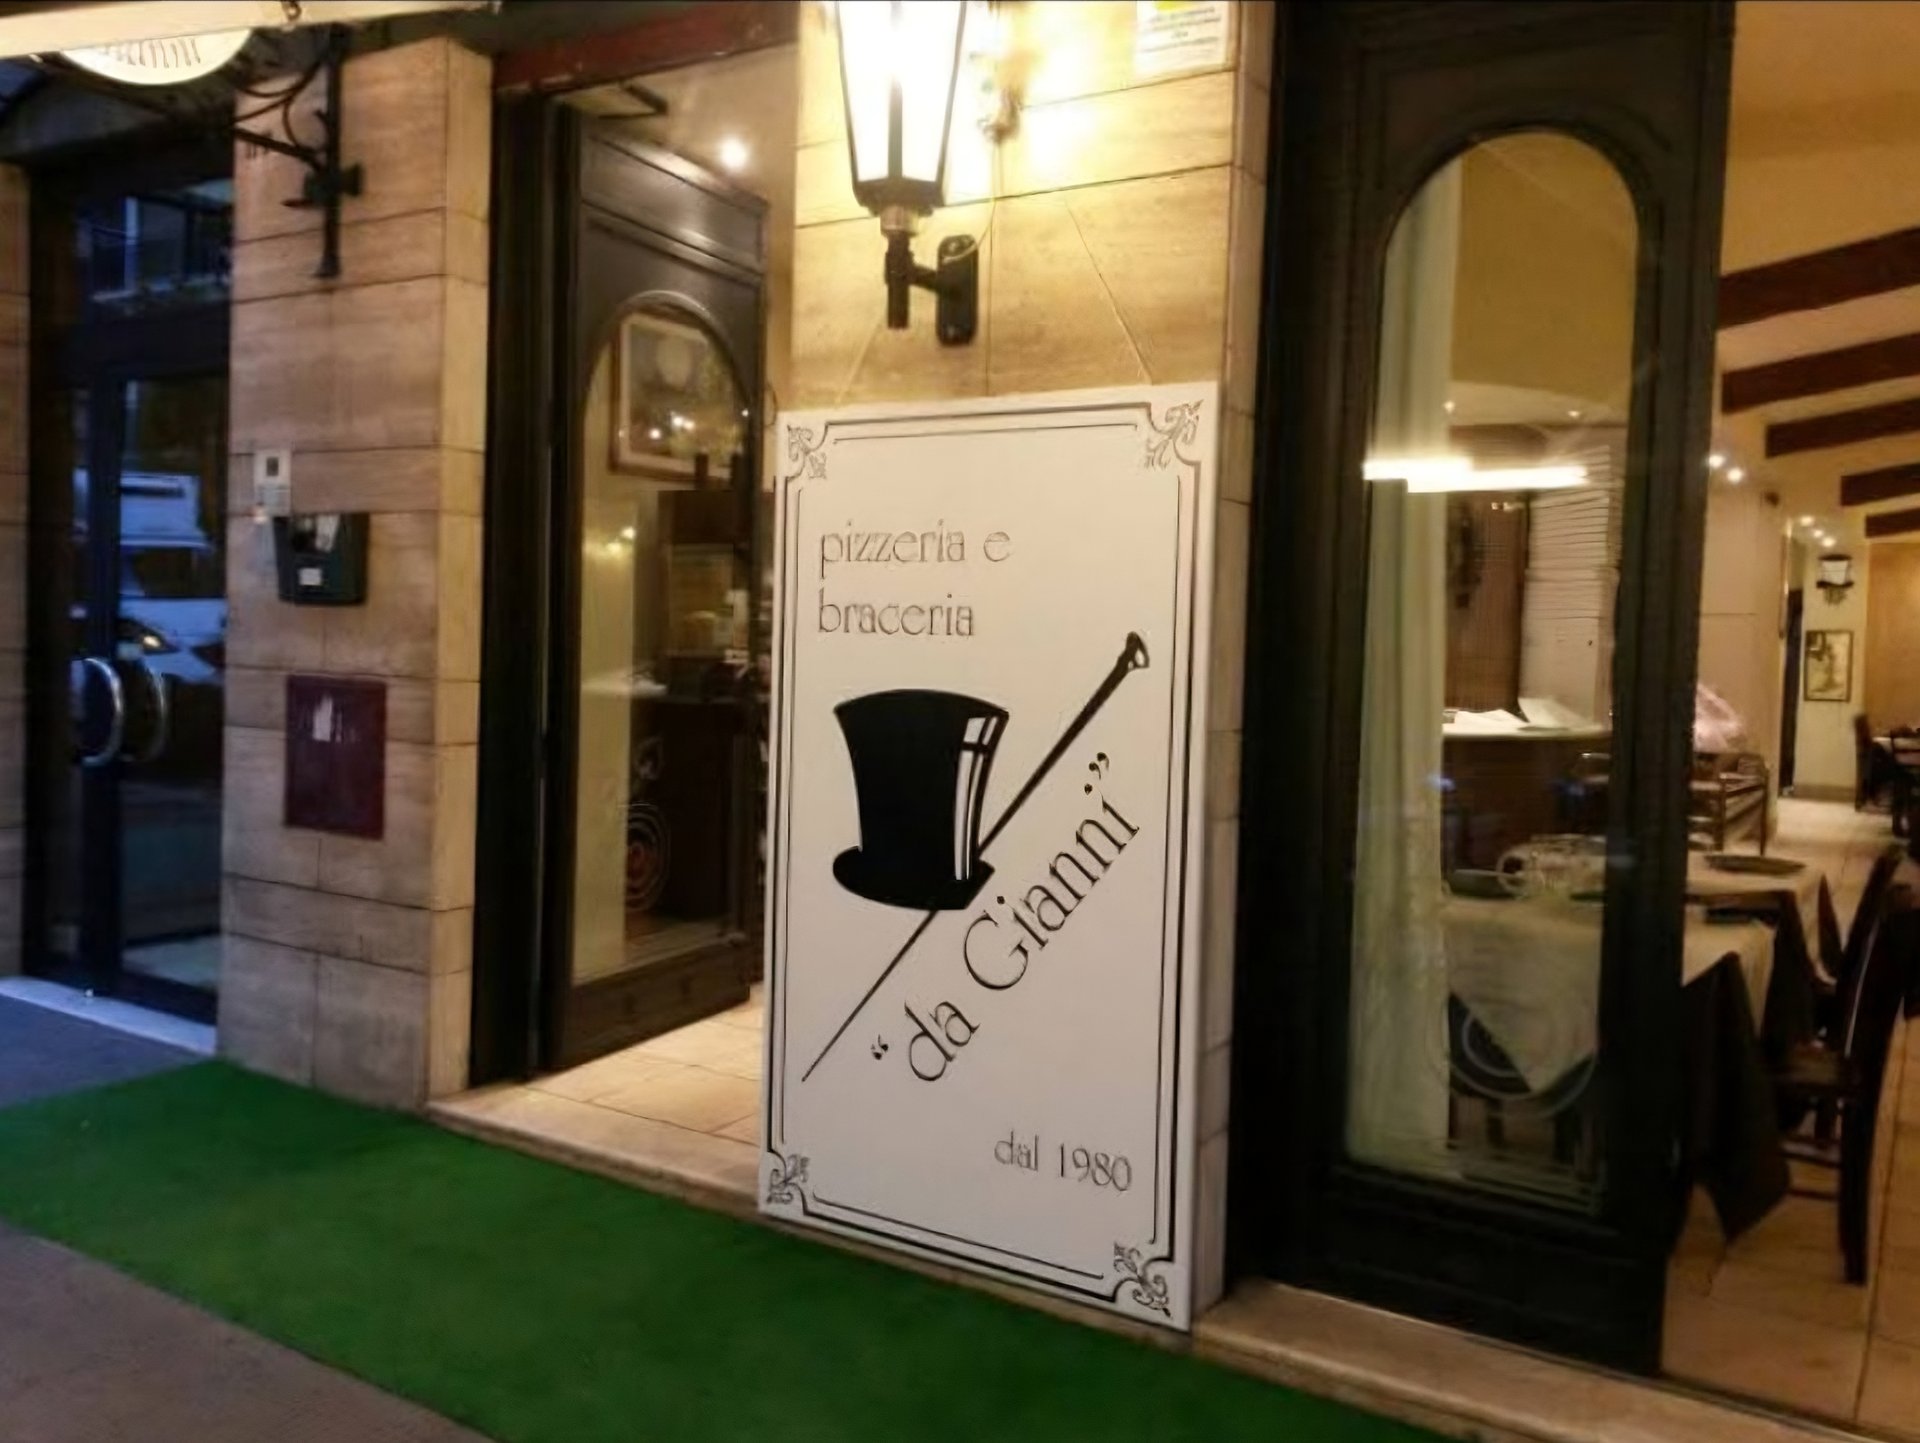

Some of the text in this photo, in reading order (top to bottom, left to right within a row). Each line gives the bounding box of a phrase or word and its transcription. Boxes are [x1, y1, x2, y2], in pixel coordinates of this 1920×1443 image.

[820, 518, 1012, 579] pizzeria e
[818, 586, 976, 637] braceria
[994, 1129, 1133, 1193] dal 1980
